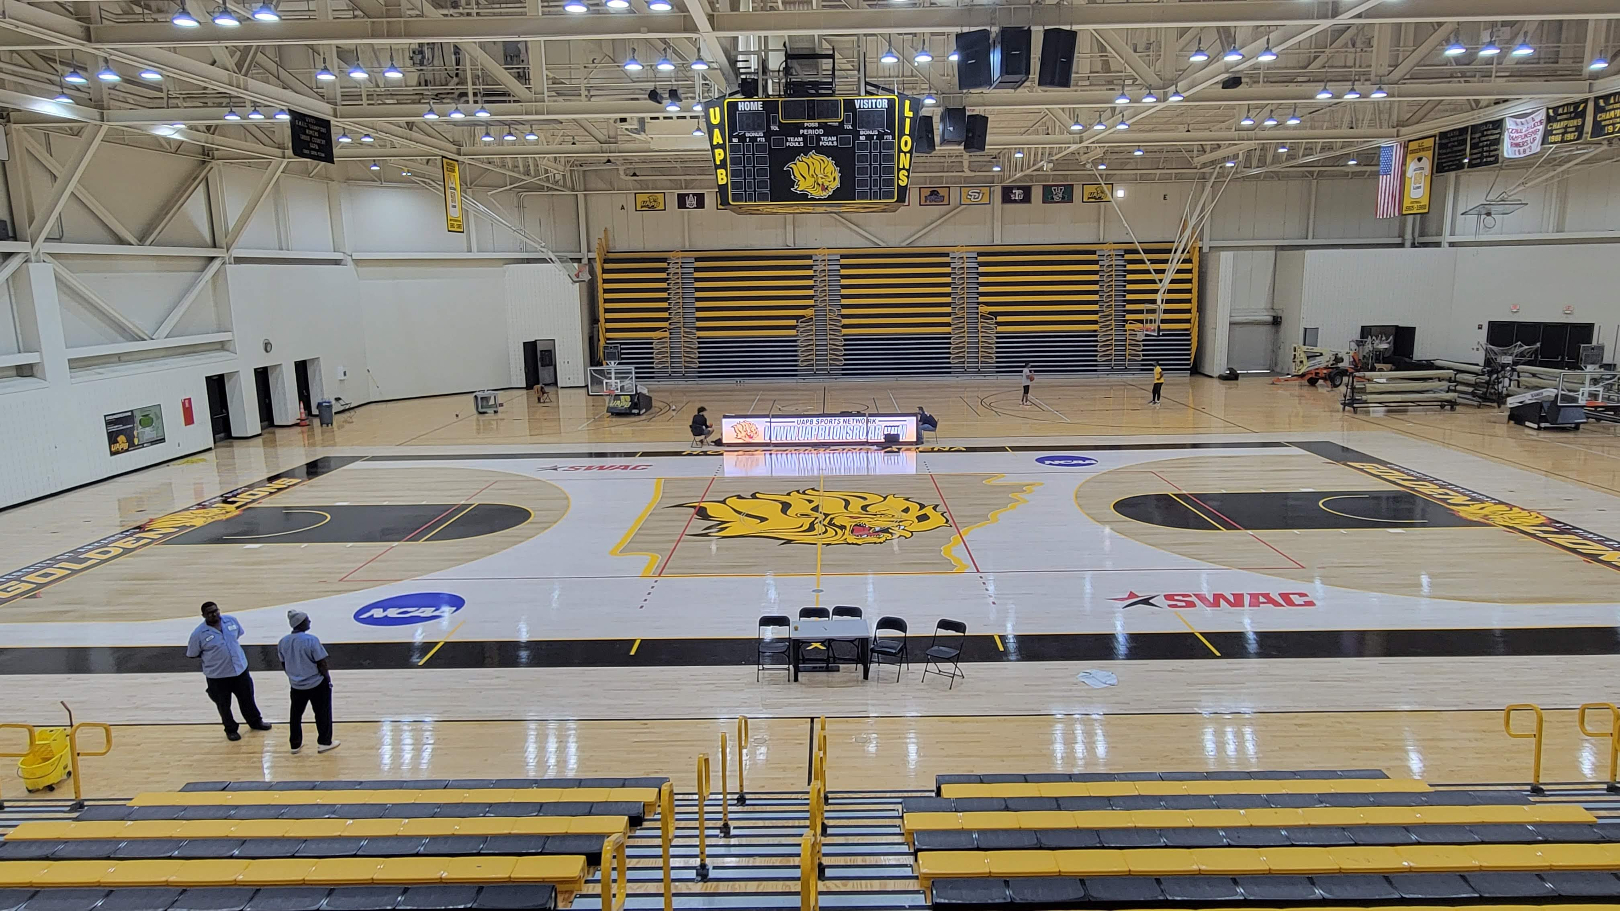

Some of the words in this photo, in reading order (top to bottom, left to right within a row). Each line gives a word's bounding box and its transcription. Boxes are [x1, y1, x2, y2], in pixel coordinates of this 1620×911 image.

[738, 102, 763, 110] HOME
[855, 100, 888, 108] VISITOR
[709, 106, 727, 184] UAPB
[898, 100, 914, 186] LIONS
[1347, 462, 1480, 505] GOLDEN
[0, 527, 179, 599] GOLDEN
[211, 478, 302, 510] LIONS
[359, 606, 457, 618] NCAA
[1164, 592, 1316, 608] SWAC
